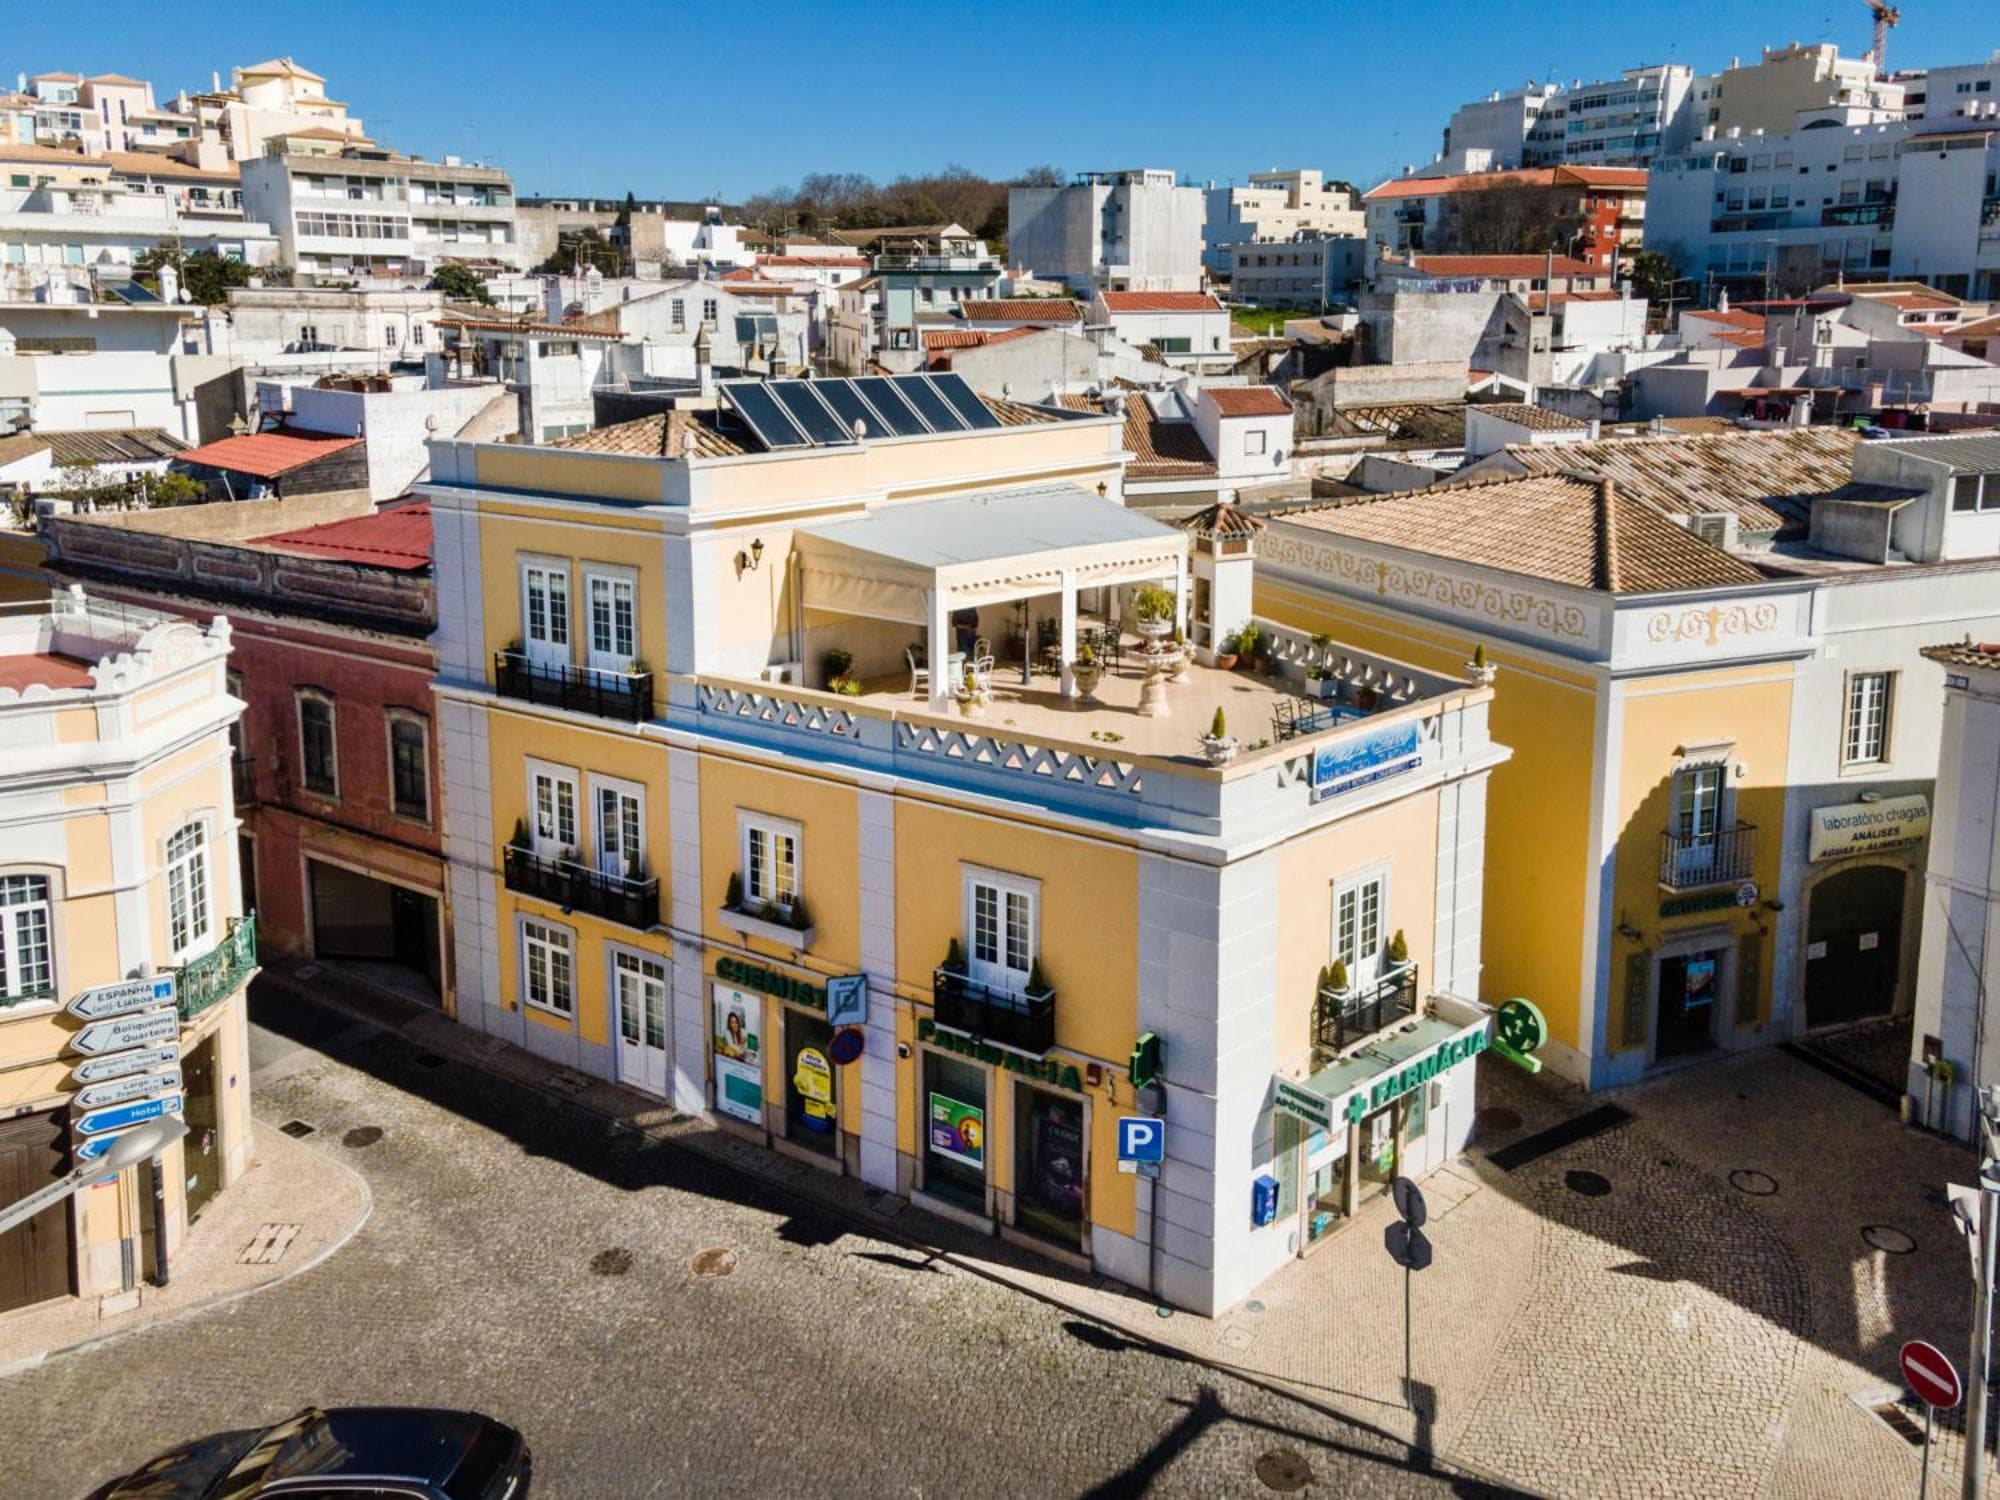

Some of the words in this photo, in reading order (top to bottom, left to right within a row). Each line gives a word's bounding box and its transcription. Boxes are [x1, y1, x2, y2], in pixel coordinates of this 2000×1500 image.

[1823, 812, 1885, 831] laboratório
[1885, 806, 1927, 822] chagas
[98, 985, 152, 1001] ESPANHA
[117, 996, 153, 1008] Lisboa
[113, 1017, 173, 1034] Boliqueime
[122, 1027, 174, 1043] Quarteira
[1371, 1029, 1488, 1110] FARMÁCIA
[131, 1104, 160, 1117] Hotel
[1127, 1123, 1153, 1155] P
